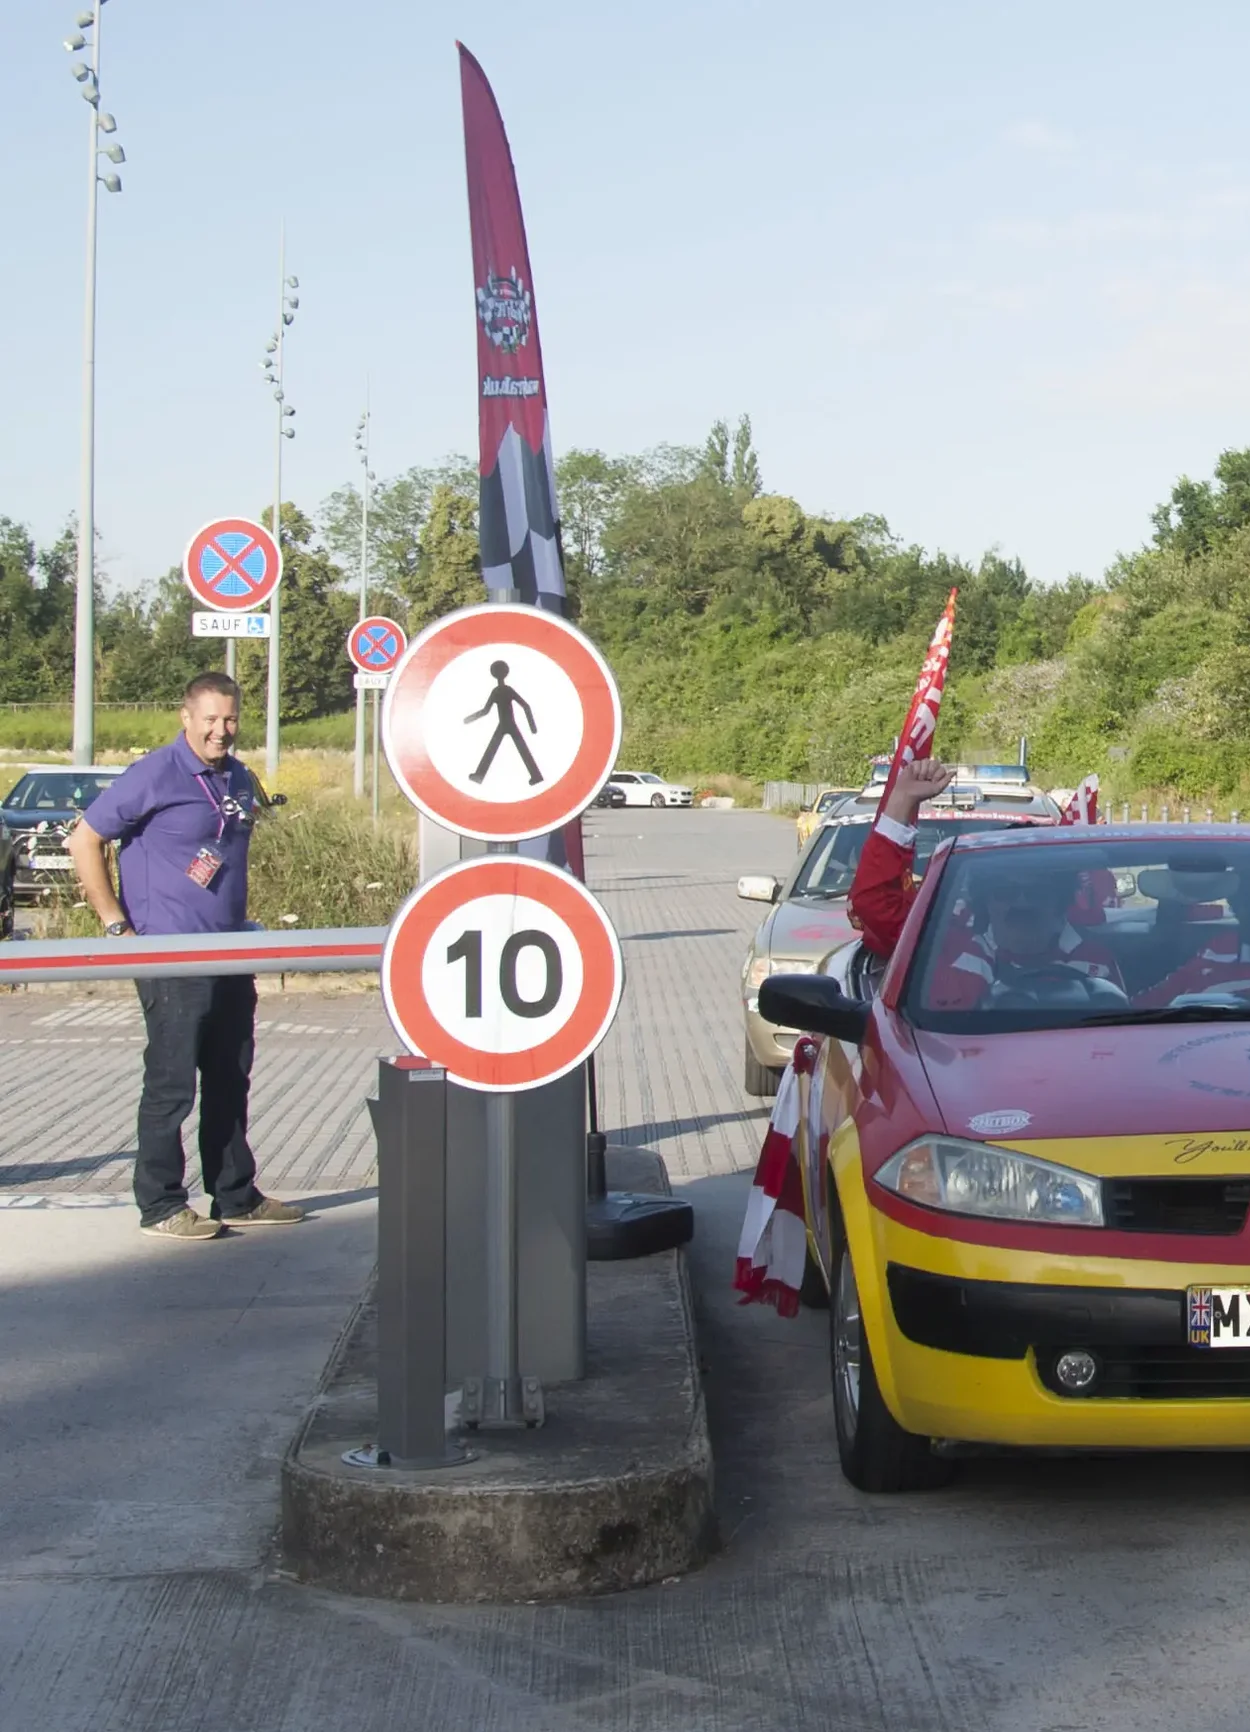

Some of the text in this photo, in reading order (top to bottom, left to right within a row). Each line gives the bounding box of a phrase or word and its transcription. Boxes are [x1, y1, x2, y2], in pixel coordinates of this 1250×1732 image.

[200, 618, 242, 631] SAUF
[447, 930, 563, 1018] 10
[1191, 1330, 1210, 1344] UK
